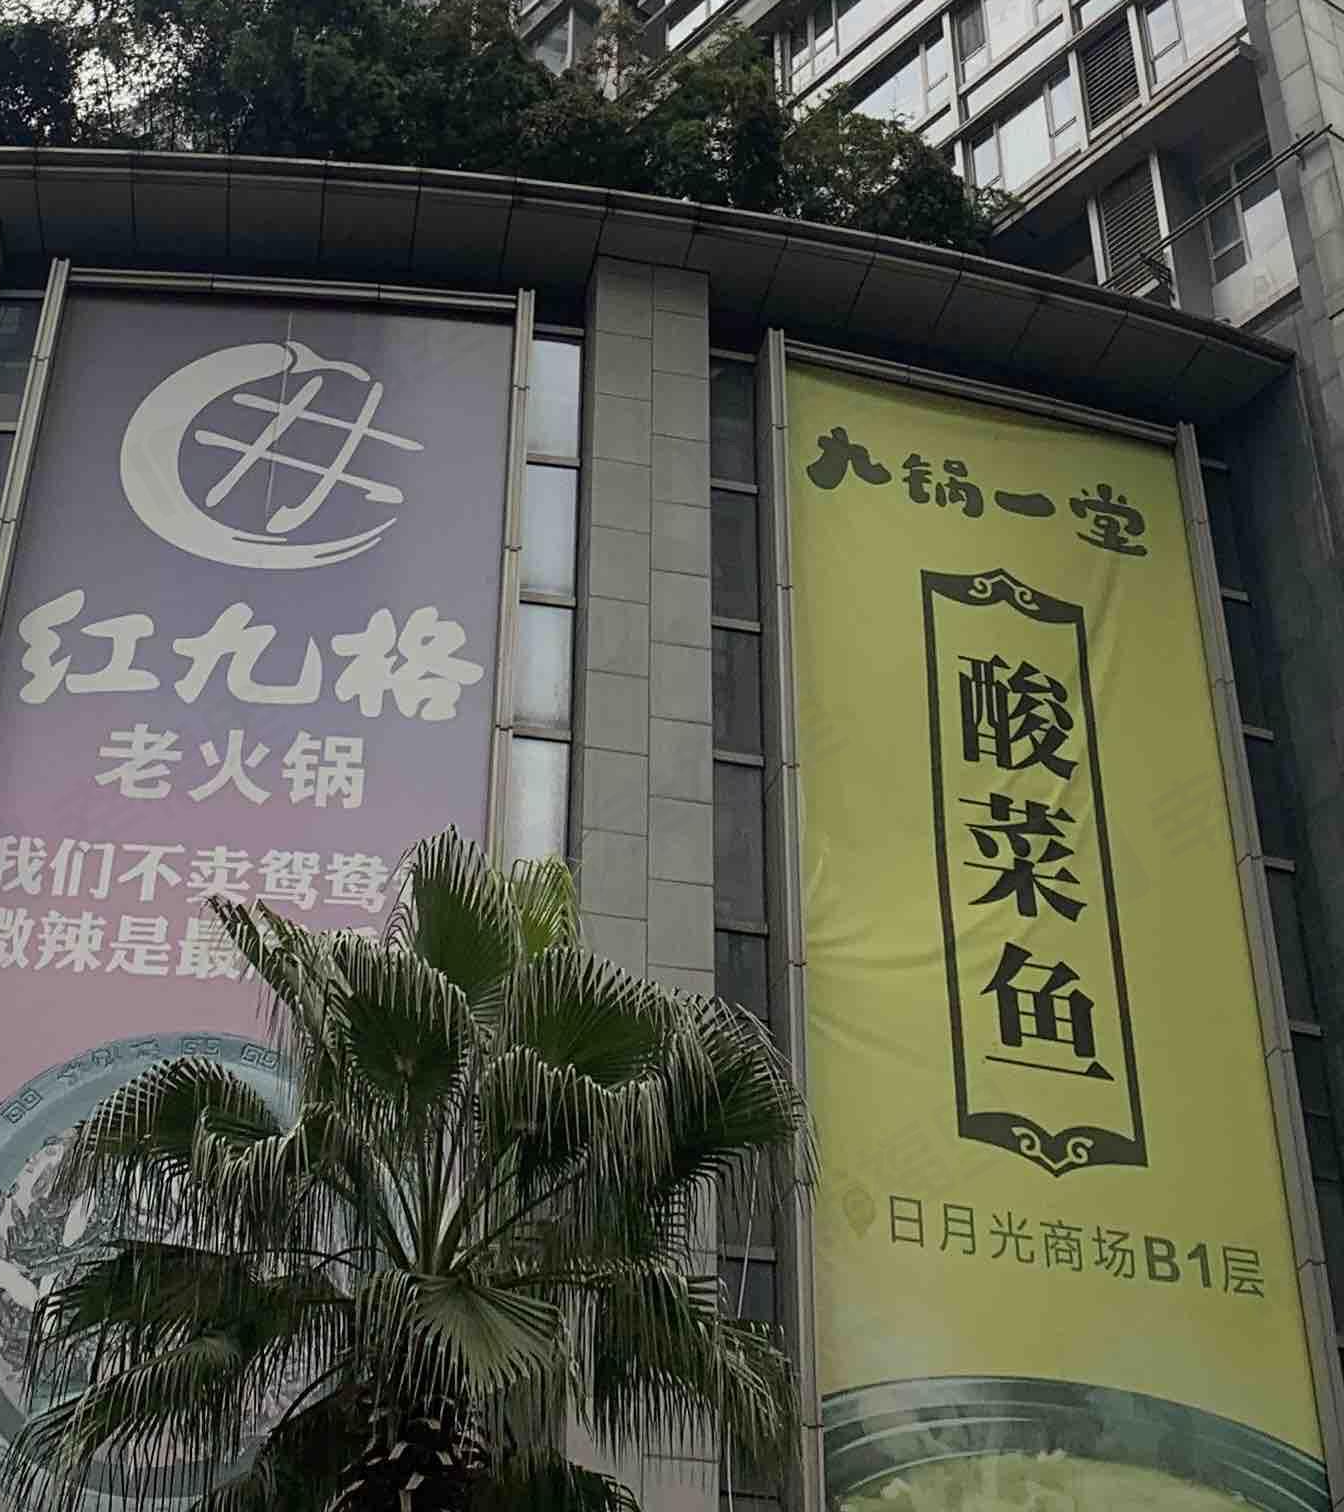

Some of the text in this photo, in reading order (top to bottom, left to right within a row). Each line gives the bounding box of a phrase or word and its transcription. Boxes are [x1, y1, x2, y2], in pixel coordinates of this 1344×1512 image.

[807, 427, 1147, 555] 九锅一堂
[18, 590, 485, 720] 红九格
[95, 724, 366, 809] 老火锅
[958, 654, 1115, 1081] 酸菜鱼
[889, 1194, 1265, 1299] 日月光商场B1层
